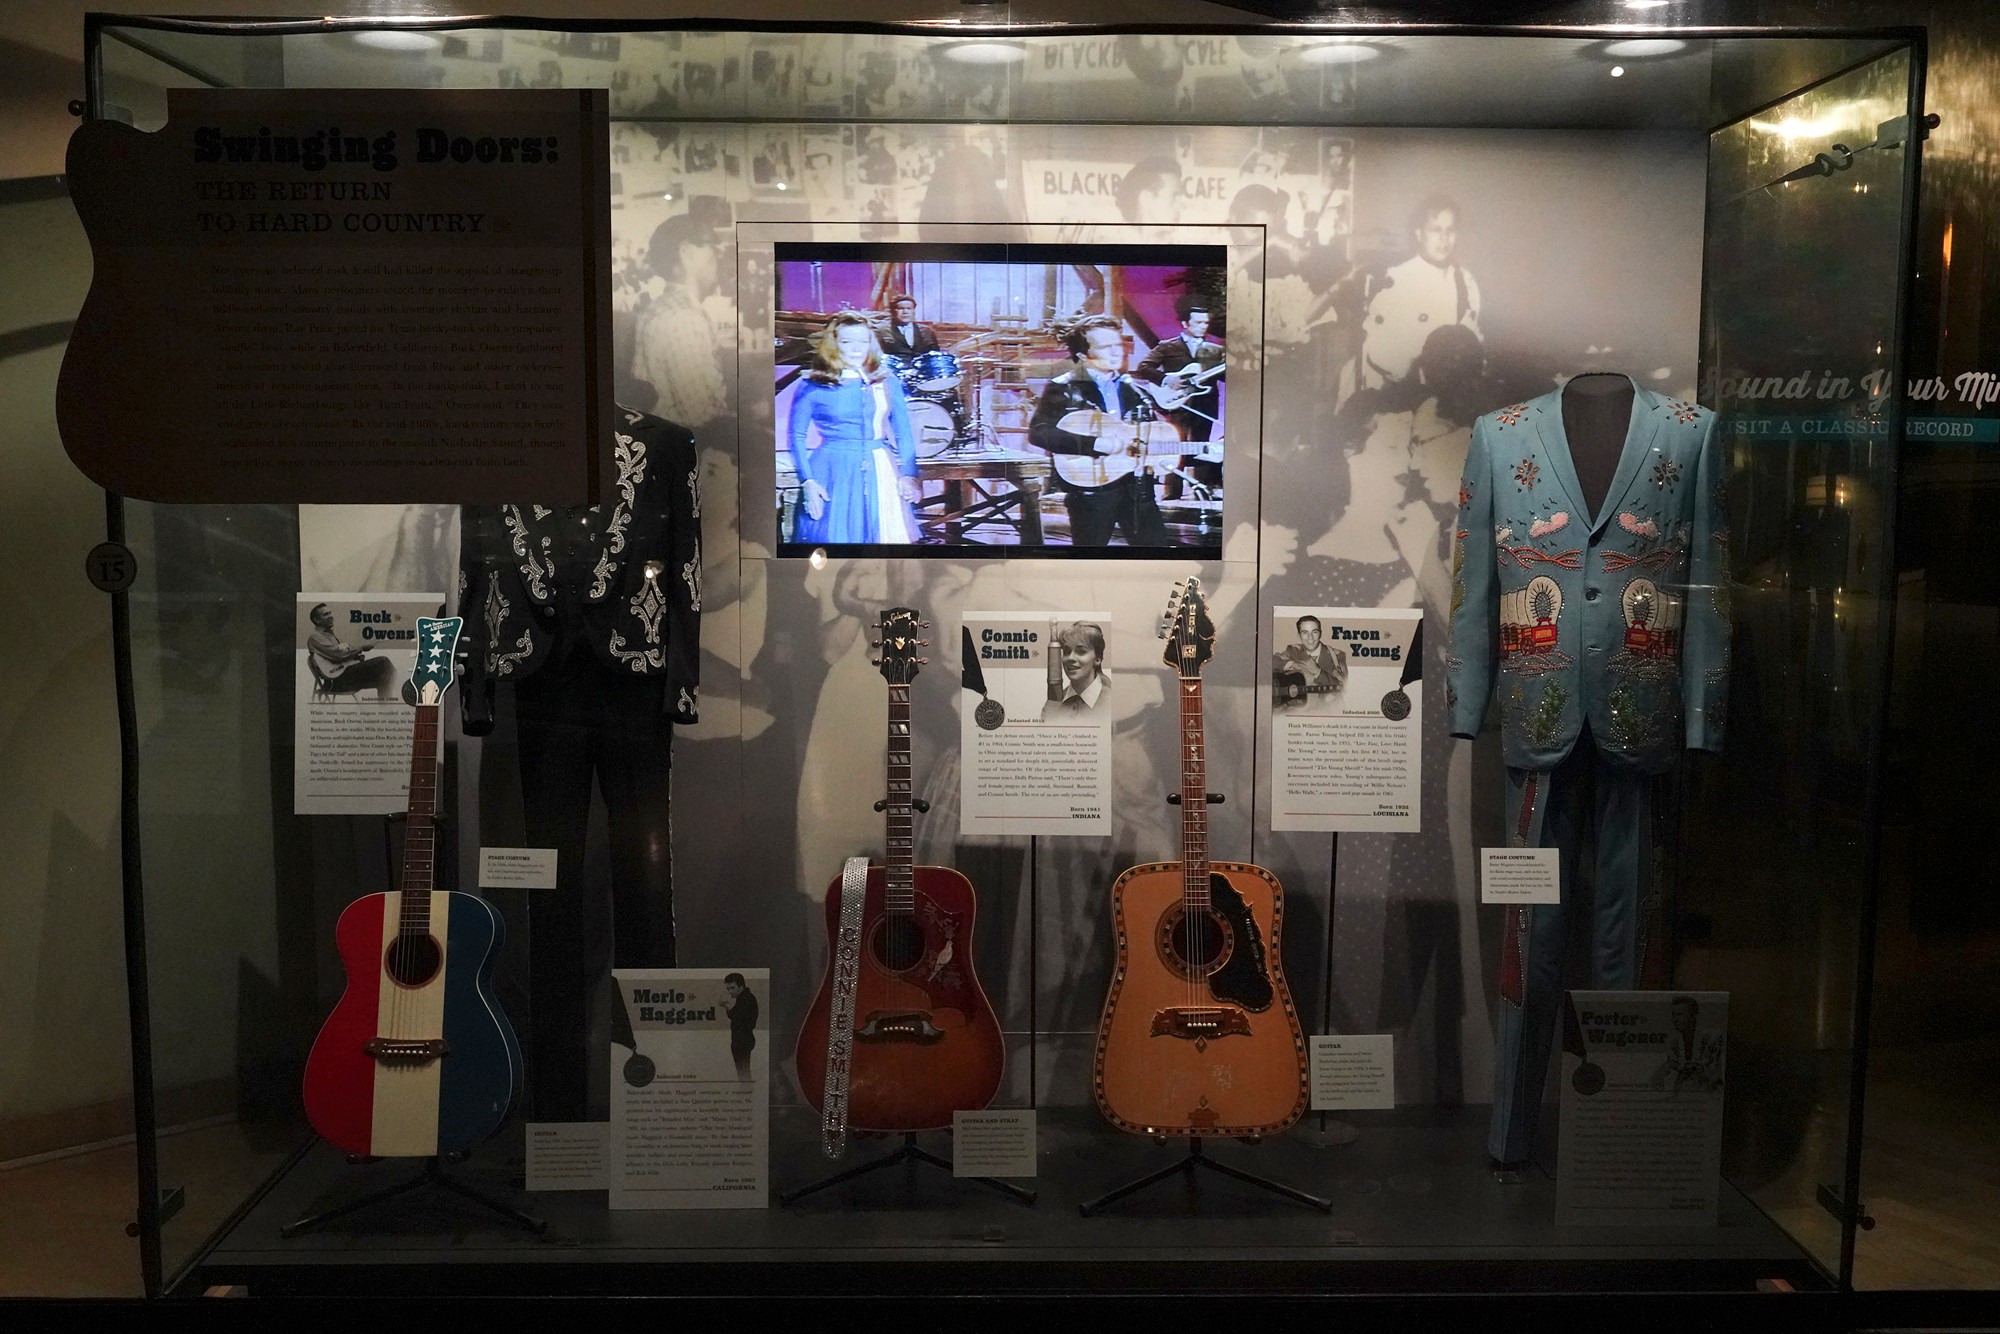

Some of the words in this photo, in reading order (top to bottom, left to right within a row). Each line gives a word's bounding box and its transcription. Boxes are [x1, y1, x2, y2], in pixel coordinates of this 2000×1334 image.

[193, 126, 398, 172] Swinging
[416, 128, 560, 164] Doors:
[196, 181, 258, 201] THE
[268, 181, 392, 201] RETURN
[1182, 176, 1226, 200] CAFE
[196, 213, 236, 233] TO
[246, 213, 332, 233] HARD
[343, 213, 486, 233] COUNTRY
[1817, 370, 1854, 400] in
[1860, 368, 1950, 412] Yur
[1954, 371, 2000, 410] Mi
[1778, 420, 1794, 434] A
[100, 560, 124, 582] 15
[350, 610, 392, 624] Buck
[362, 626, 415, 640] Owens
[981, 628, 1038, 643] Connie
[1331, 626, 1380, 640] Faron
[981, 645, 1030, 659] Smith
[1350, 643, 1401, 661] Young
[836, 926, 856, 1032] CONNIE
[633, 989, 685, 1004] Merle
[640, 1006, 716, 1025] Haggard
[1581, 1011, 1639, 1025] Porter
[1587, 1029, 1668, 1046] Wagoner
[829, 1042, 847, 1130] SMITH
